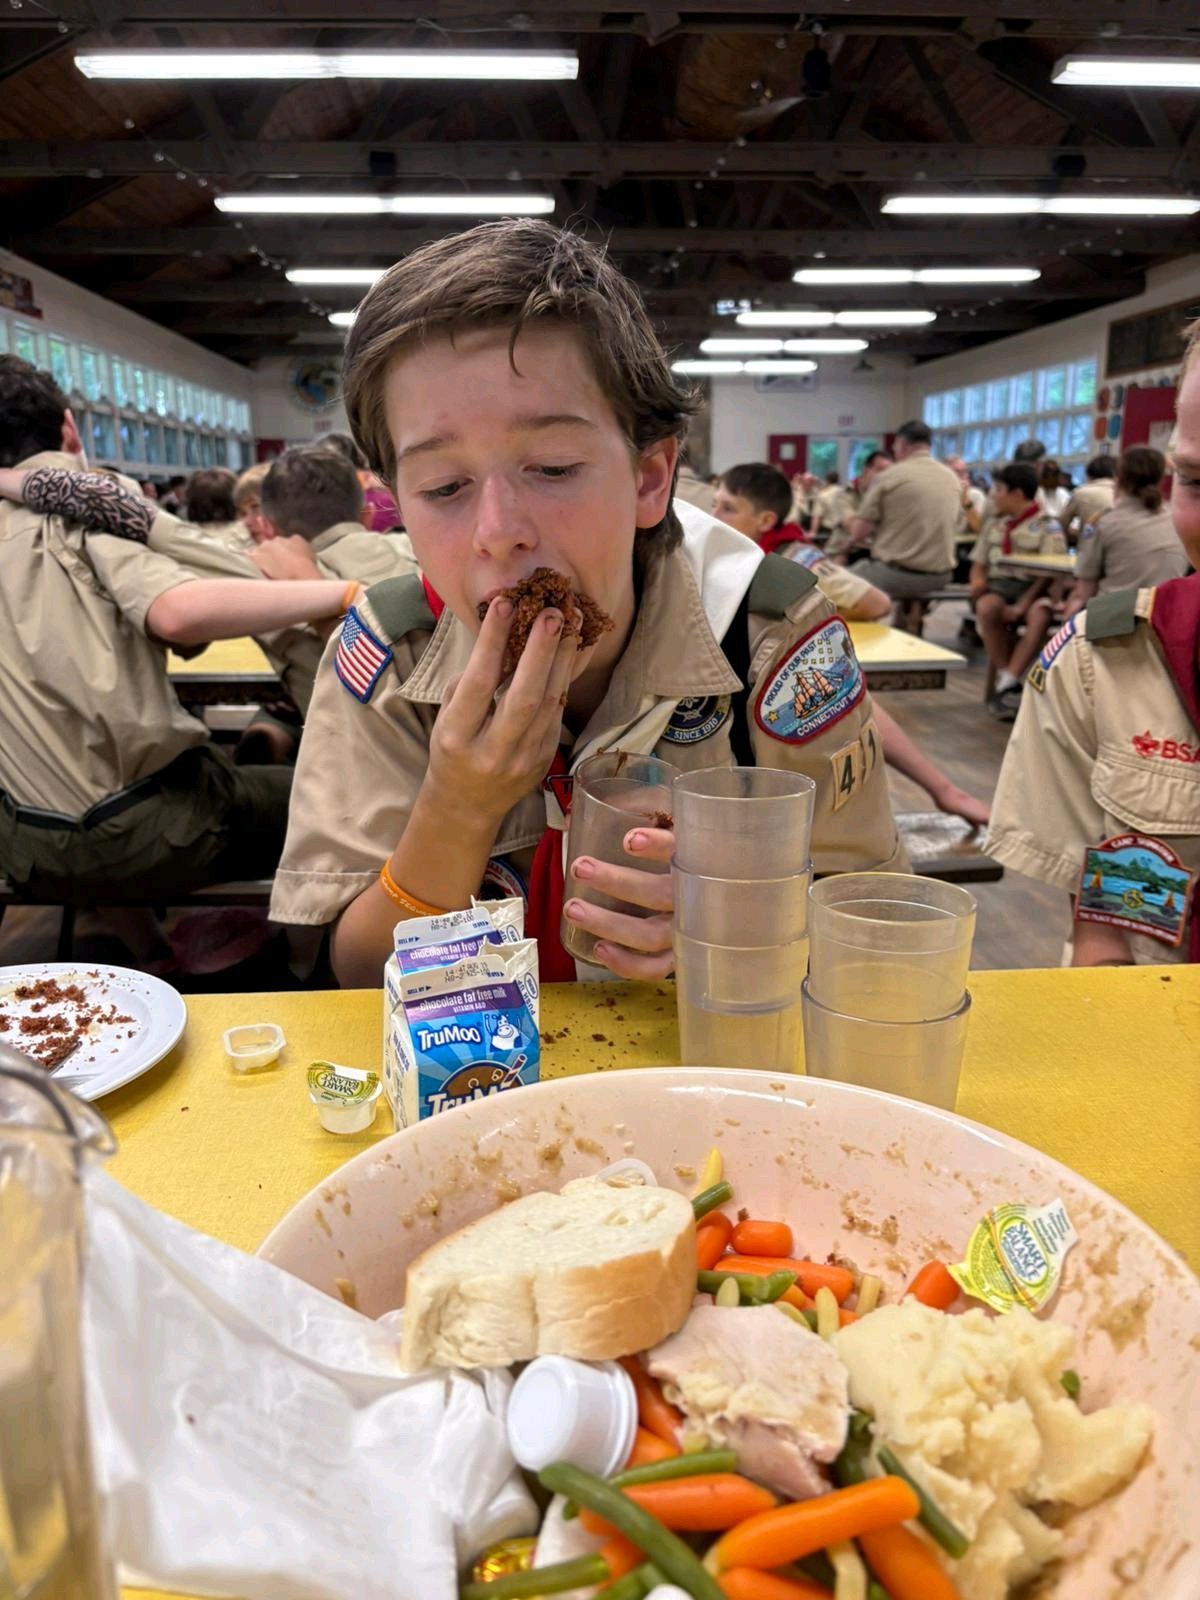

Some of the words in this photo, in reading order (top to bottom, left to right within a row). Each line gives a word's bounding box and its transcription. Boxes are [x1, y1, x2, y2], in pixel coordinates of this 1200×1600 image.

[764, 679, 783, 706] PROUD
[780, 669, 791, 682] OF
[787, 656, 803, 672] OUR
[800, 639, 818, 660] PAST
[674, 730, 701, 740] SINCE
[702, 717, 719, 734] 1910
[797, 699, 849, 737] CONNECTICUT
[409, 945, 449, 960] chocolate
[449, 943, 461, 955] fat
[462, 940, 477, 953] free
[420, 996, 463, 1011] chocolate
[463, 991, 476, 1003] fat
[477, 989, 493, 1001] free
[493, 986, 507, 998] milk
[452, 1004, 474, 1013] VITAMIN
[417, 1026, 481, 1051] TruMoo
[321, 1073, 359, 1090] BALANCE
[322, 1079, 354, 1097] SMART
[1003, 1225, 1040, 1281] BALANCE
[1017, 1221, 1047, 1270] SMART
